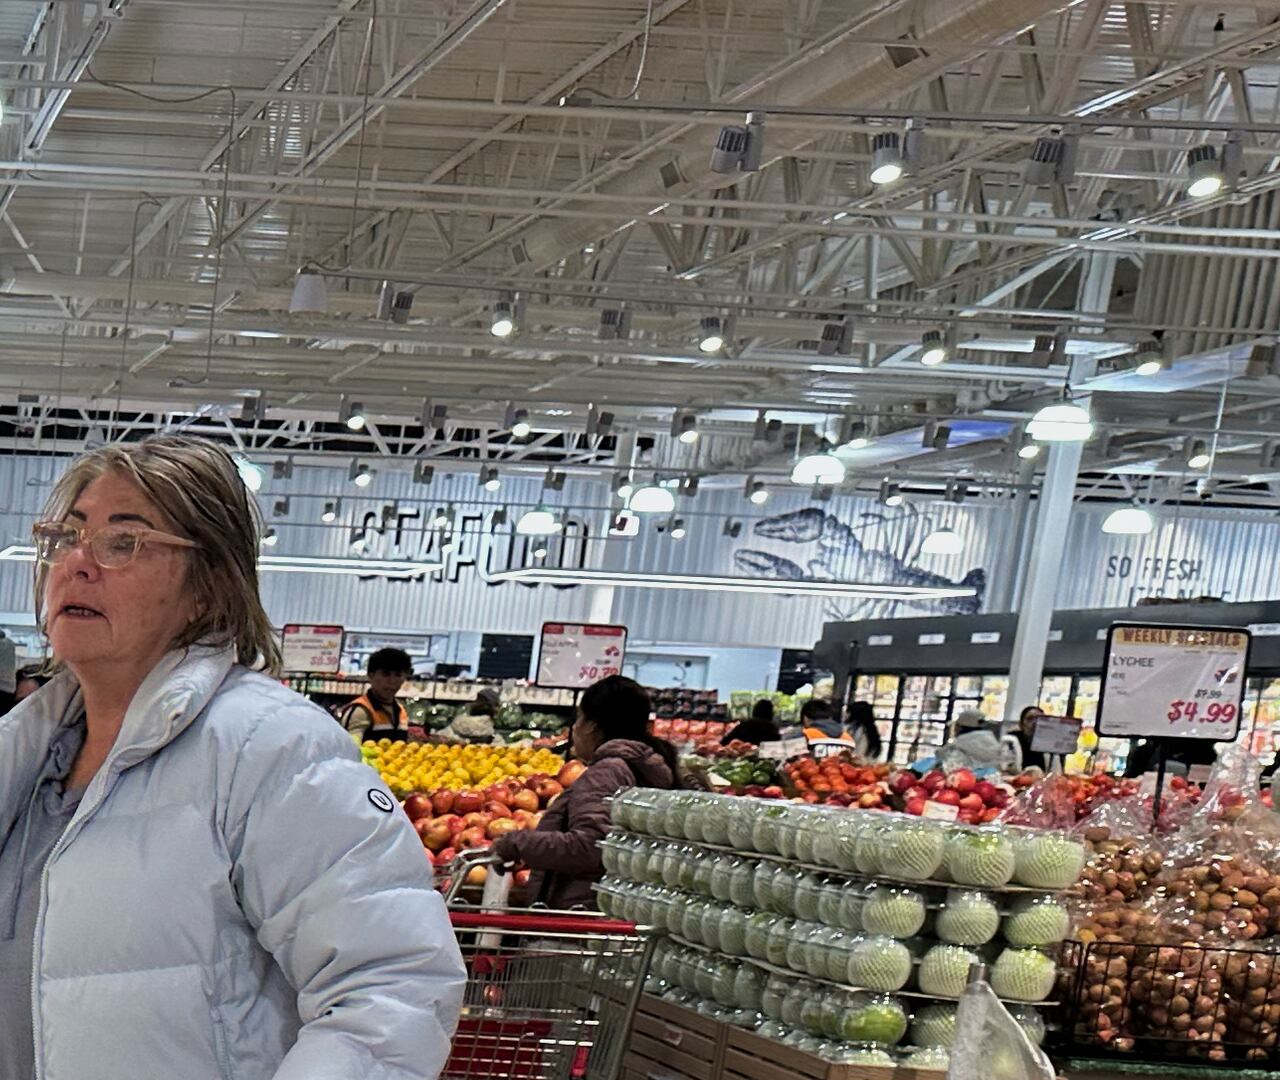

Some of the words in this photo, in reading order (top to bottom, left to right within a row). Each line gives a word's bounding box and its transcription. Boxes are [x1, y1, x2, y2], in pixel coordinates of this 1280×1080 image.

[1107, 556, 1132, 578] SO
[1123, 629, 1172, 644] WEEKLY
[1177, 630, 1241, 647] SPECIALS
[1113, 656, 1155, 668] LYCHEE
[1168, 700, 1236, 724] $4.99
